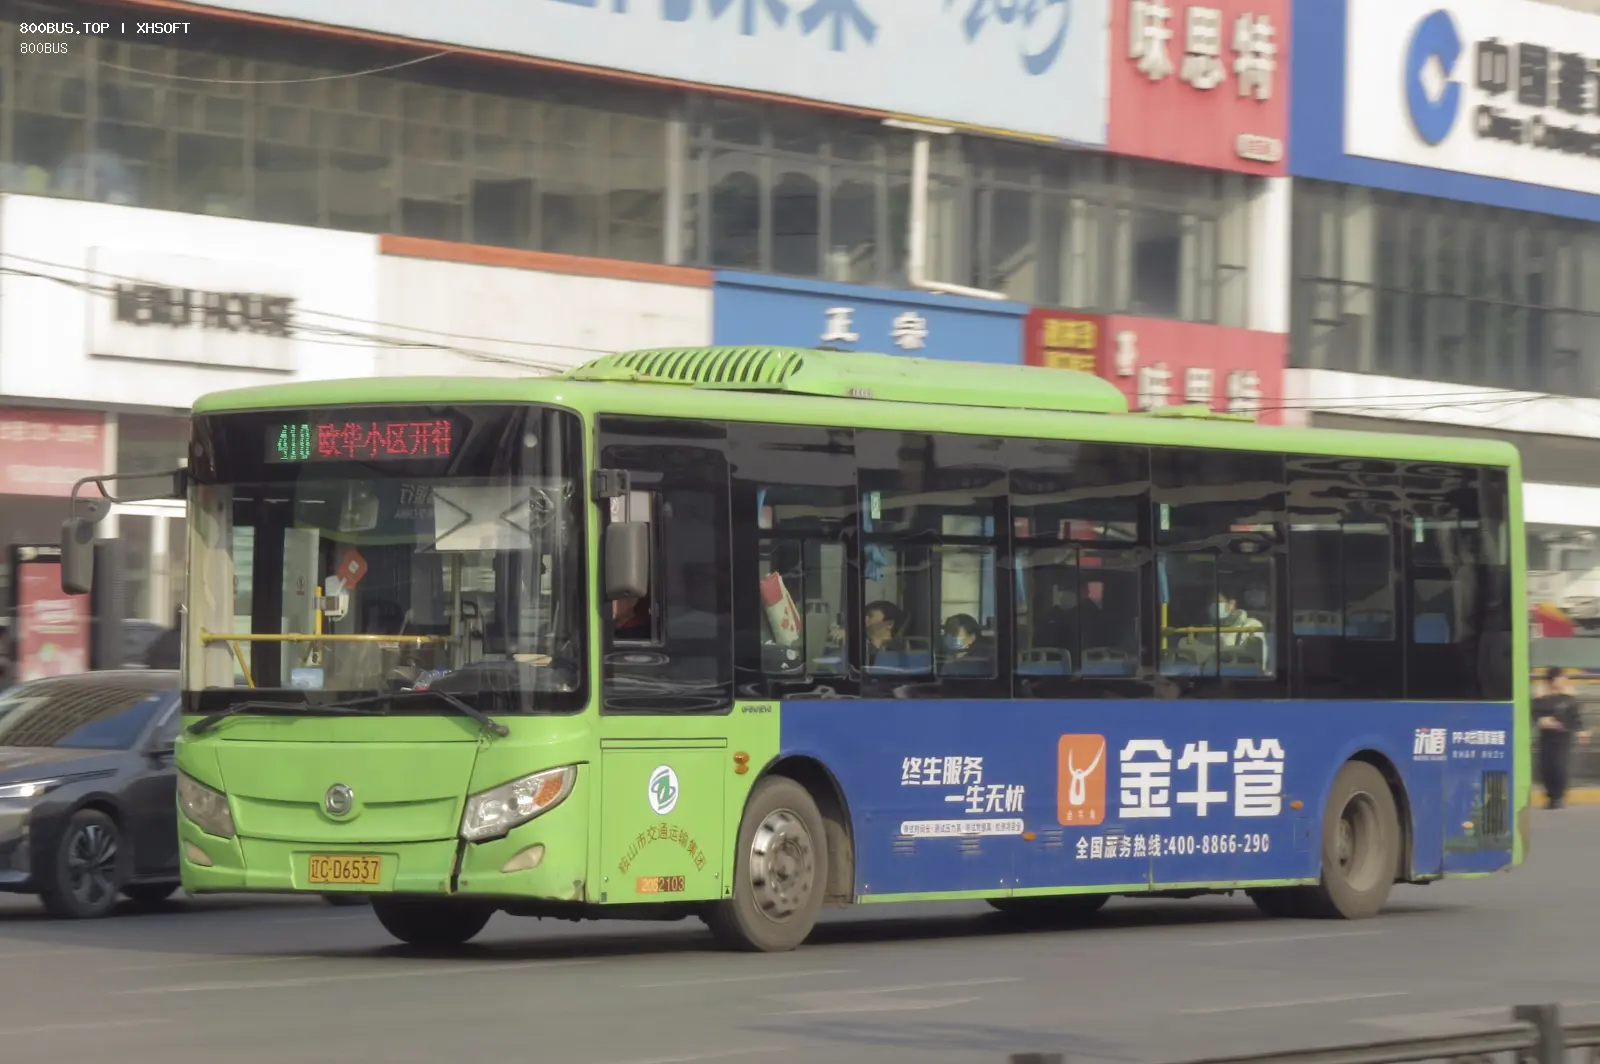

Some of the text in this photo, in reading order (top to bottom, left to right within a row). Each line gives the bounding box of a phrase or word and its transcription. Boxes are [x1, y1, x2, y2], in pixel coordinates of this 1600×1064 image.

[901, 756, 984, 785] 终生服务
[1118, 738, 1285, 818] 金牛管
[944, 784, 1025, 813] 一生无忧
